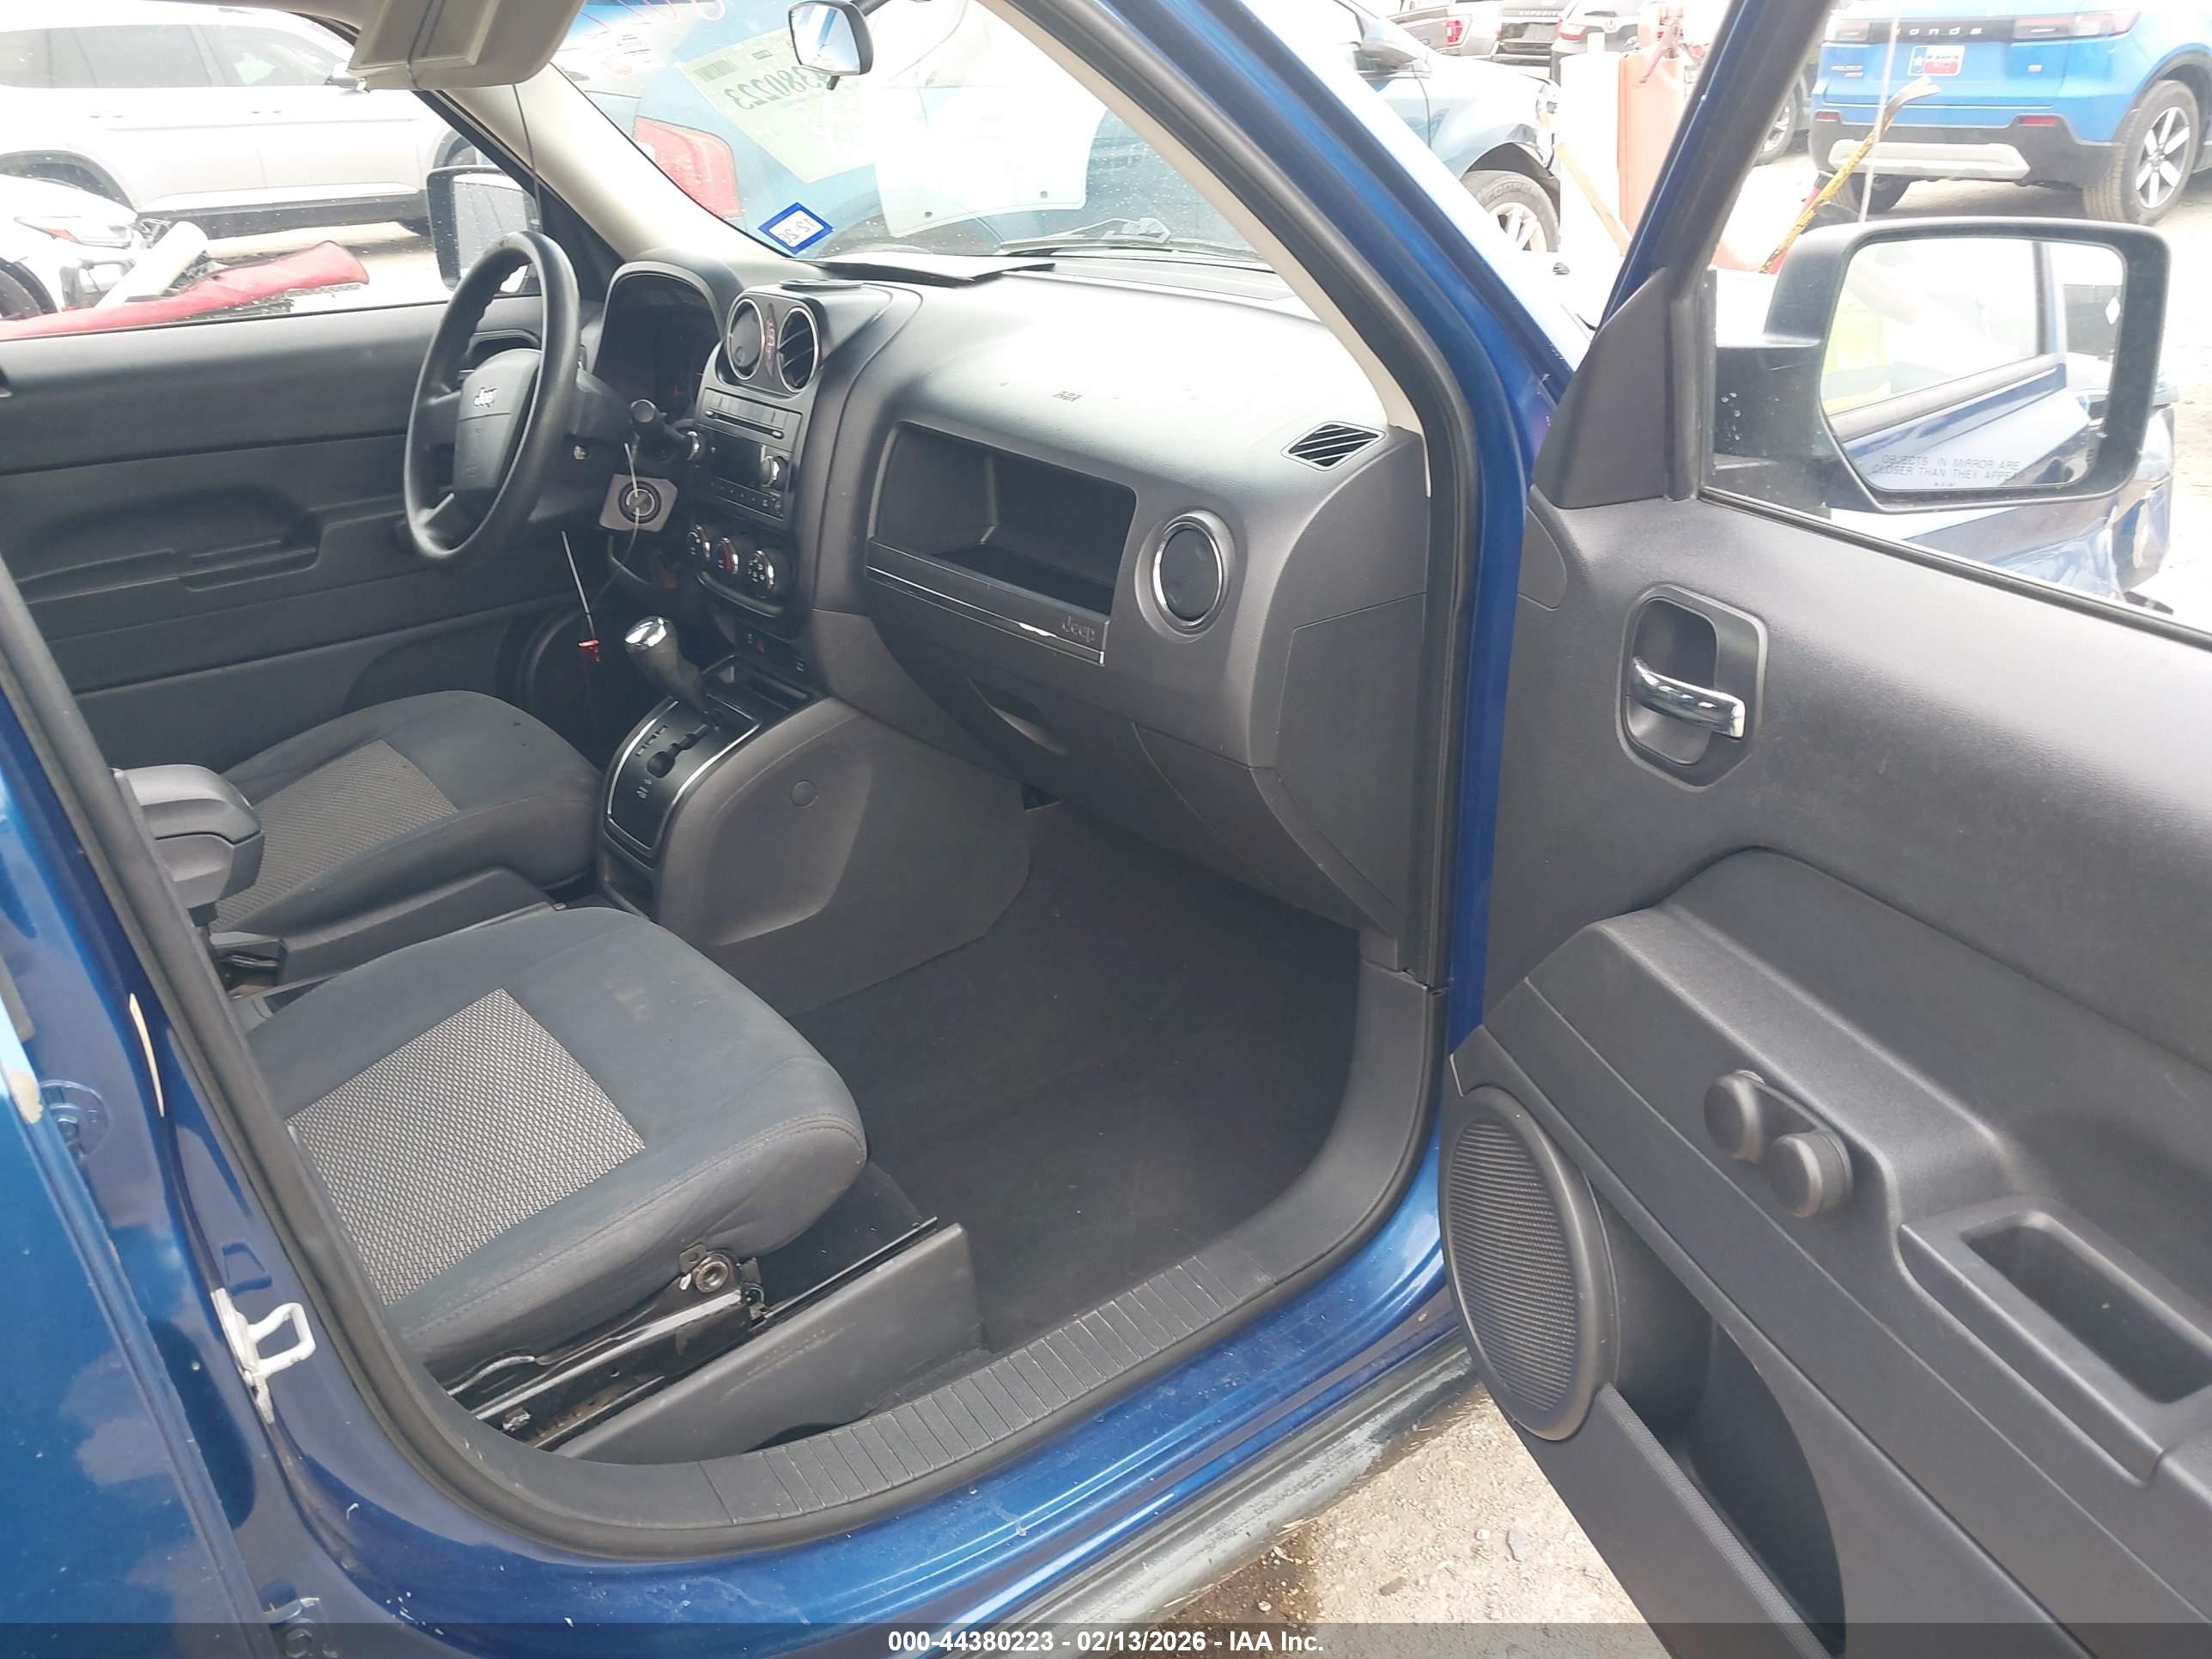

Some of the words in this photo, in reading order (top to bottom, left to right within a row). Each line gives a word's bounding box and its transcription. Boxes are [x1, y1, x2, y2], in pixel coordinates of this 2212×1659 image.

[1881, 454, 1929, 466] OBJECTS
[1954, 459, 1993, 469] MIRROR
[1061, 616, 1097, 643] Jeep
